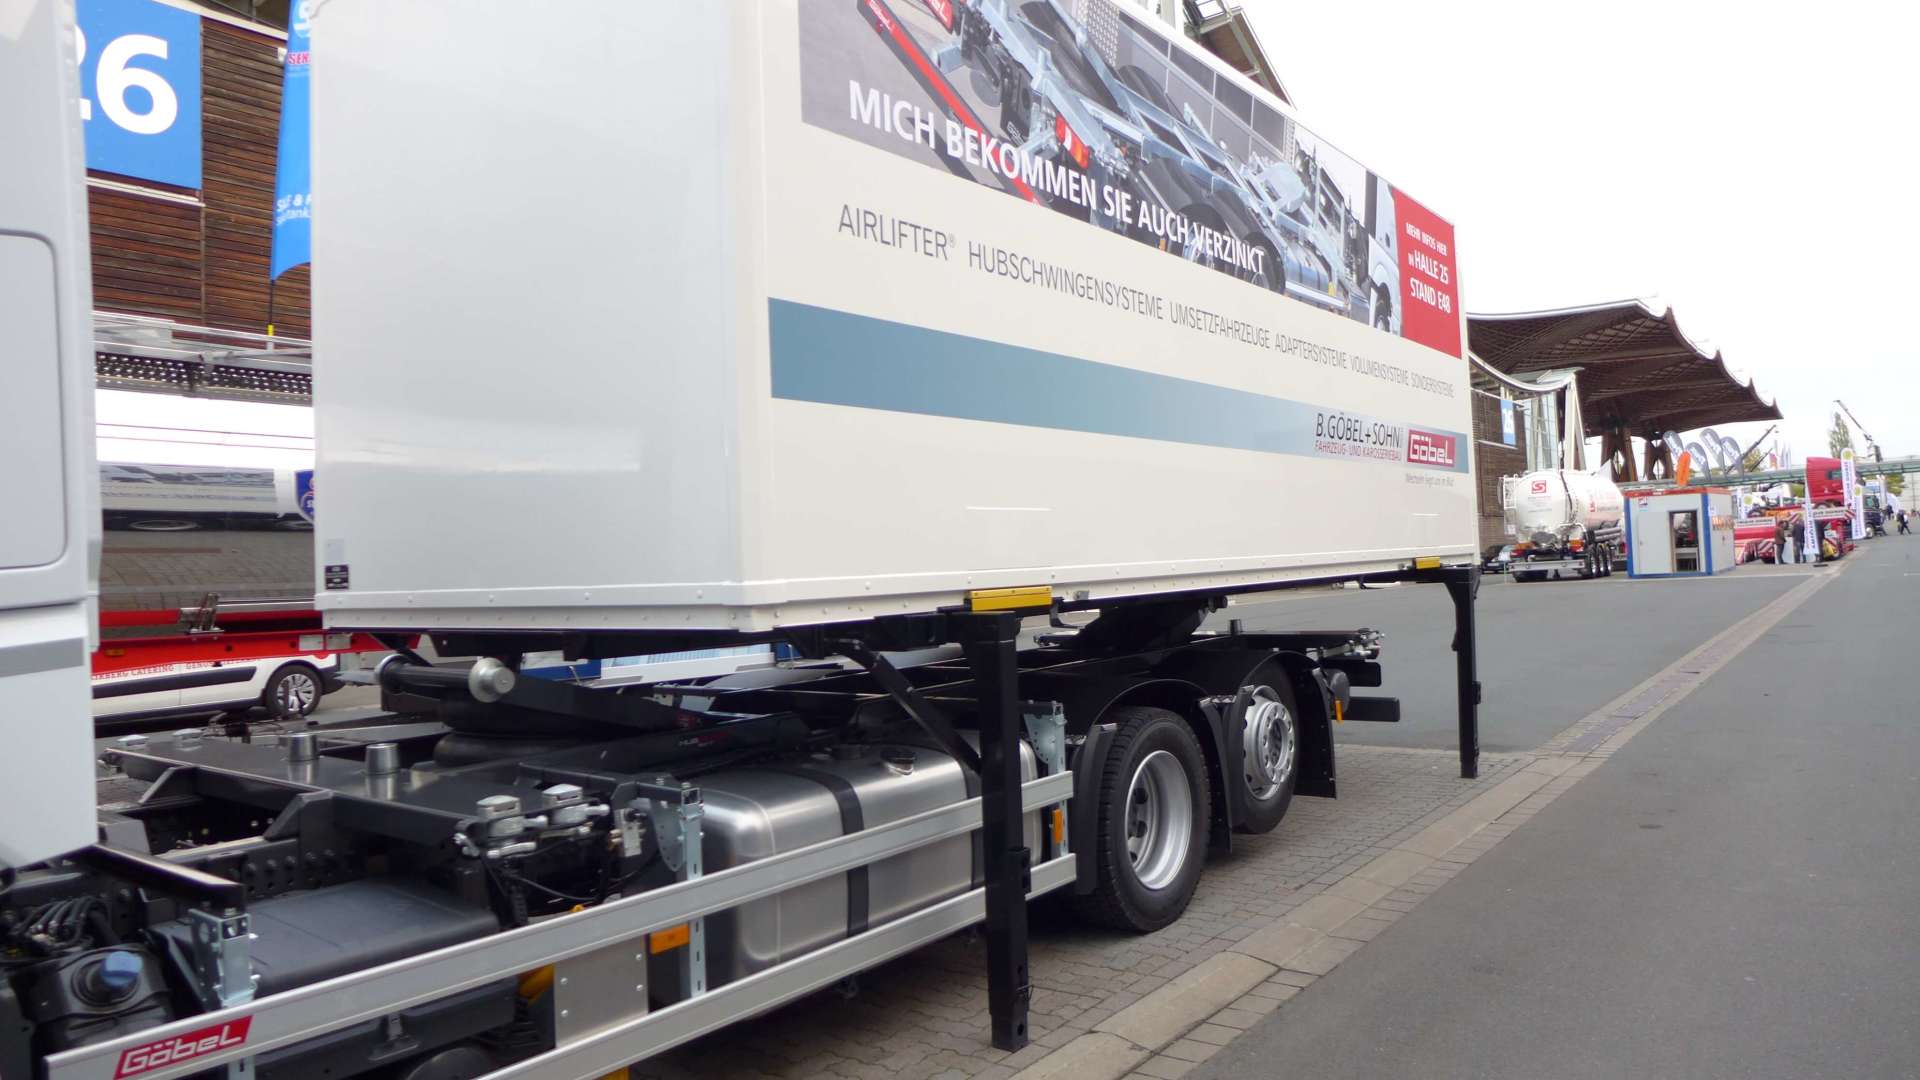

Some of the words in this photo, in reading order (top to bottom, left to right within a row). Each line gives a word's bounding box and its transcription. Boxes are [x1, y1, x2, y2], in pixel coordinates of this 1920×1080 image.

[849, 79, 935, 150] MICH
[946, 118, 1096, 211] BEKOMMEN
[1102, 184, 1133, 225] SIE
[1137, 199, 1190, 246] AUCH
[1193, 222, 1265, 275] VERZINKT
[968, 240, 1164, 320] HUBSCHWINGENSYSTEME
[1169, 301, 1270, 350] UMSETZFAHRZEUGE
[1274, 333, 1347, 370] ADAPTERSYSTEME
[1410, 277, 1437, 306] STAND
[1438, 290, 1451, 314] E48
[1414, 250, 1440, 280] HALLE
[1440, 262, 1449, 285] 25
